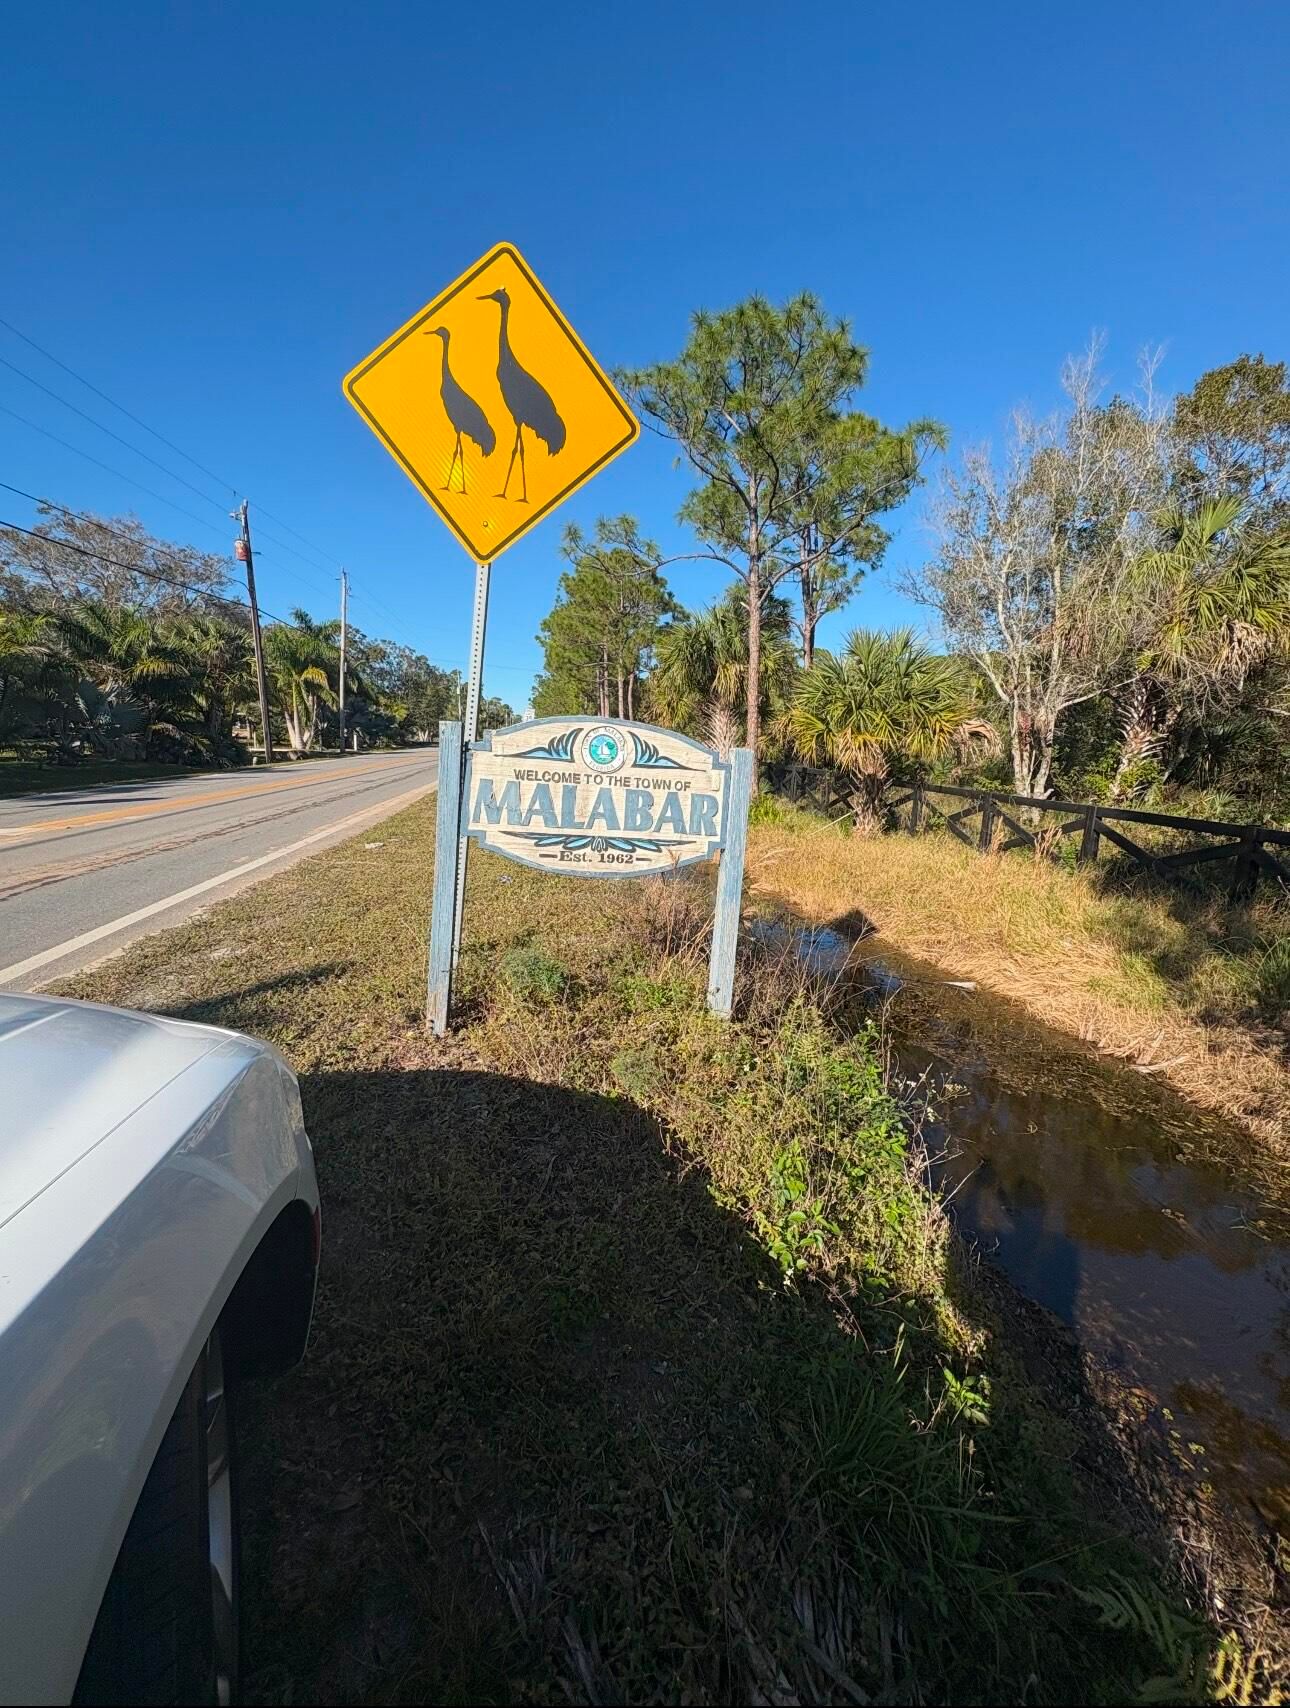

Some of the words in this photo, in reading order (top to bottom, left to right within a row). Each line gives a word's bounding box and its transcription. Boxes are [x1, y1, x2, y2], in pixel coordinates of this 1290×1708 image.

[513, 768, 581, 785] WELCOME
[584, 773, 604, 785] TO
[606, 775, 631, 788] THE
[634, 777, 672, 791] TOWN
[674, 780, 692, 792] OF
[471, 778, 720, 836] MALABAR
[559, 850, 593, 862] Est.
[597, 852, 634, 864] 1962
